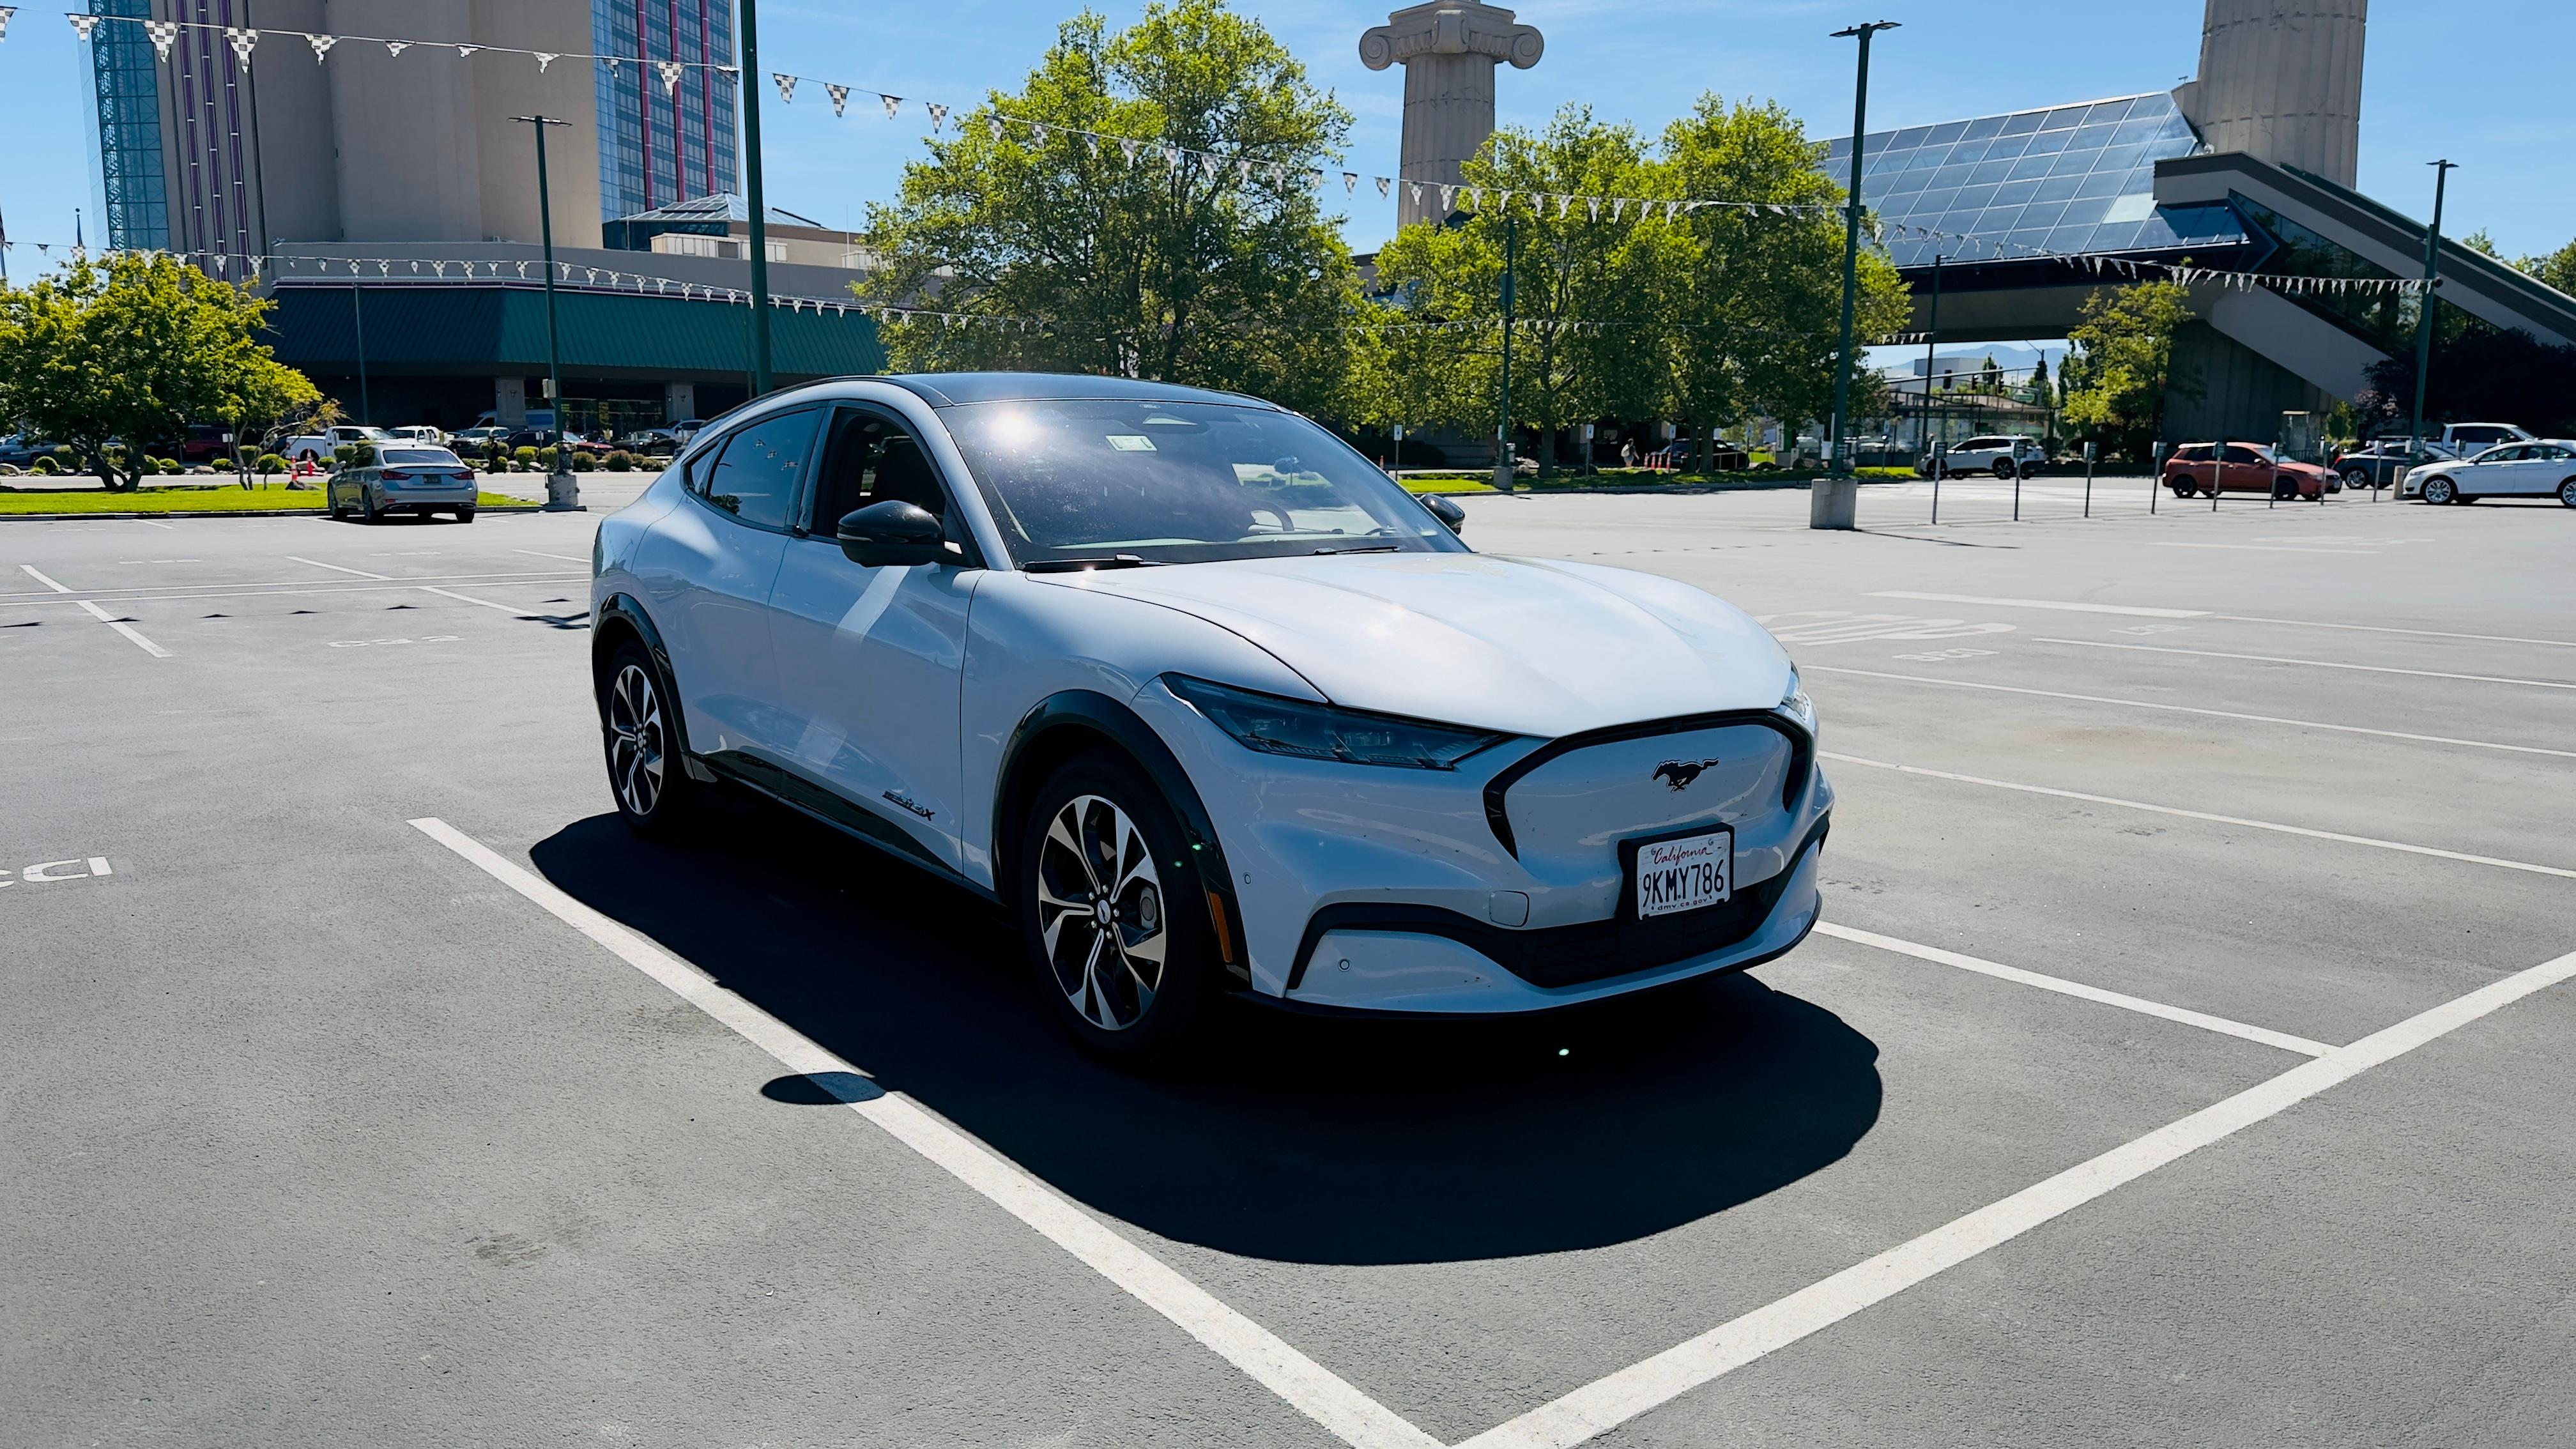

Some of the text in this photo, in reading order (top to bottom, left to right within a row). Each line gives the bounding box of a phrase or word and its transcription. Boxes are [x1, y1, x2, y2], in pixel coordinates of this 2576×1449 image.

[1653, 845, 1713, 866] California
[1643, 859, 1724, 908] 9KMY786
[1657, 896, 1708, 910] dmv.ca.gov
